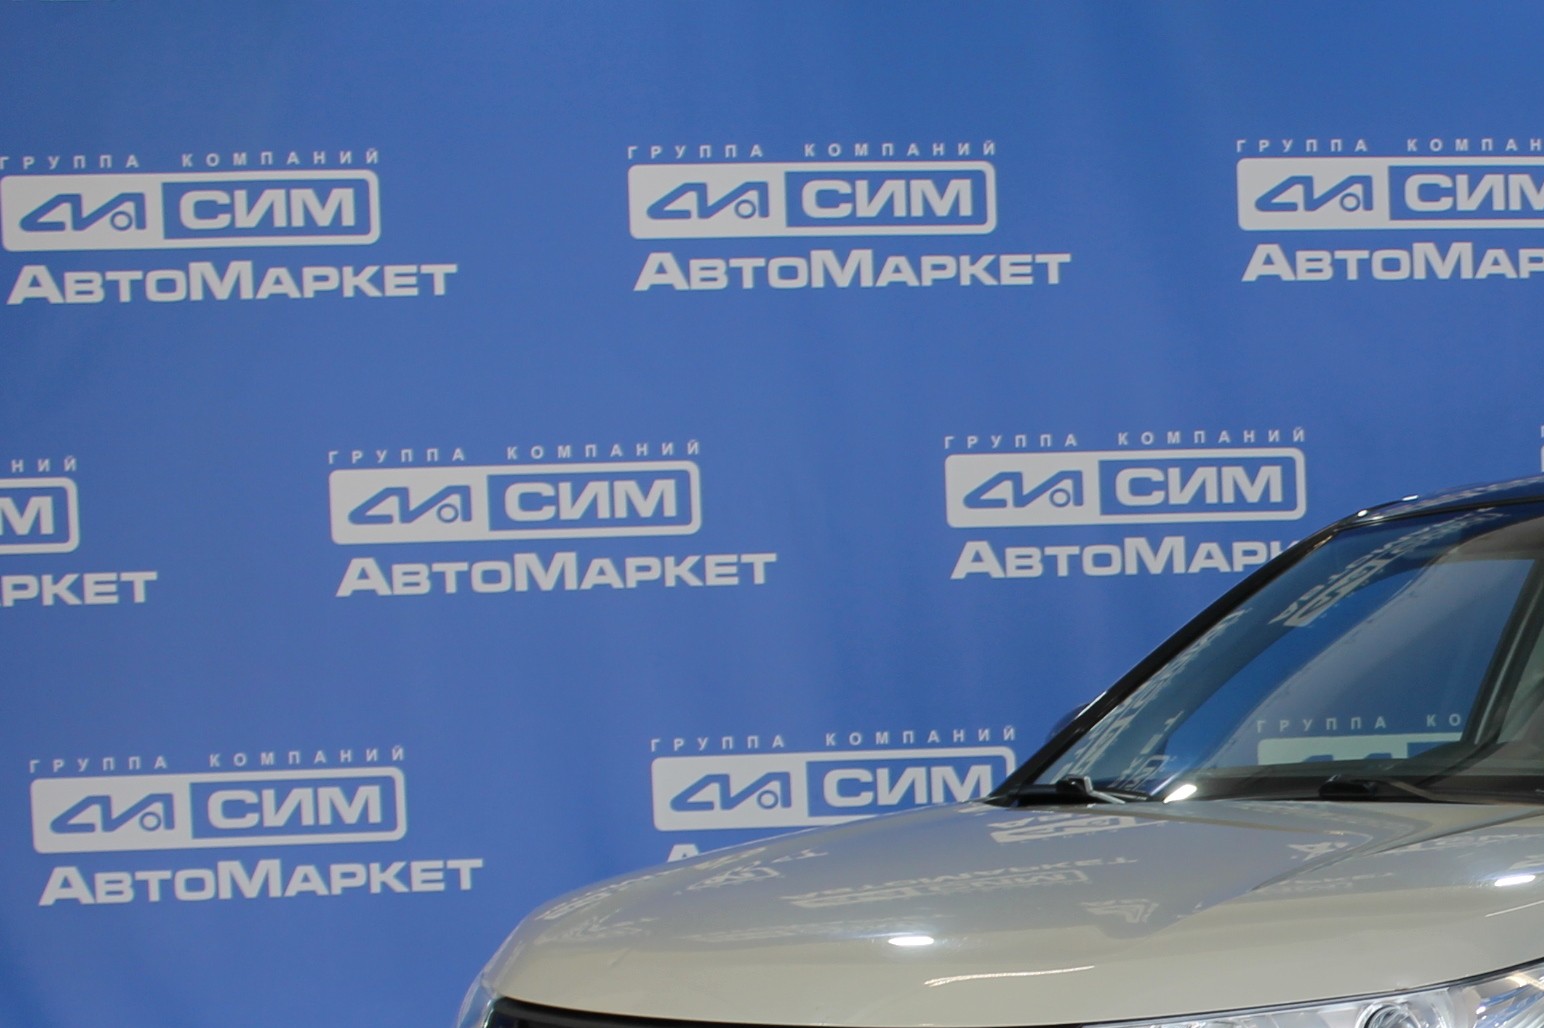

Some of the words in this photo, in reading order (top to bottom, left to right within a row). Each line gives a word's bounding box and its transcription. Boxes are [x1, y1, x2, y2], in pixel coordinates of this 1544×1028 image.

[0, 154, 139, 170] ГРУППА
[181, 147, 379, 167] КОМПАНИЙ
[627, 143, 763, 160] ГРУППА
[803, 139, 995, 157] КОМПАНИЙ
[1236, 138, 1368, 153] ГРУППА
[180, 188, 355, 229] СИМ
[802, 179, 972, 218] СИМ
[327, 447, 465, 465] ГРУППА
[506, 439, 699, 460] КОМПАНИЙ
[944, 433, 1077, 450] ГРУППА
[1117, 426, 1305, 446] КОМПАНИЙ
[1116, 466, 1282, 505] СИМ
[505, 479, 676, 521] СИМ
[1255, 715, 1387, 734] ГРУППА
[650, 734, 785, 753] ГРУППА
[825, 725, 1015, 747] КОМПАНИЙ
[29, 755, 167, 773] ГРУППА
[208, 744, 404, 768] КОМПАНИЙ
[823, 765, 992, 807] СИМ
[208, 785, 381, 828] СИМ
